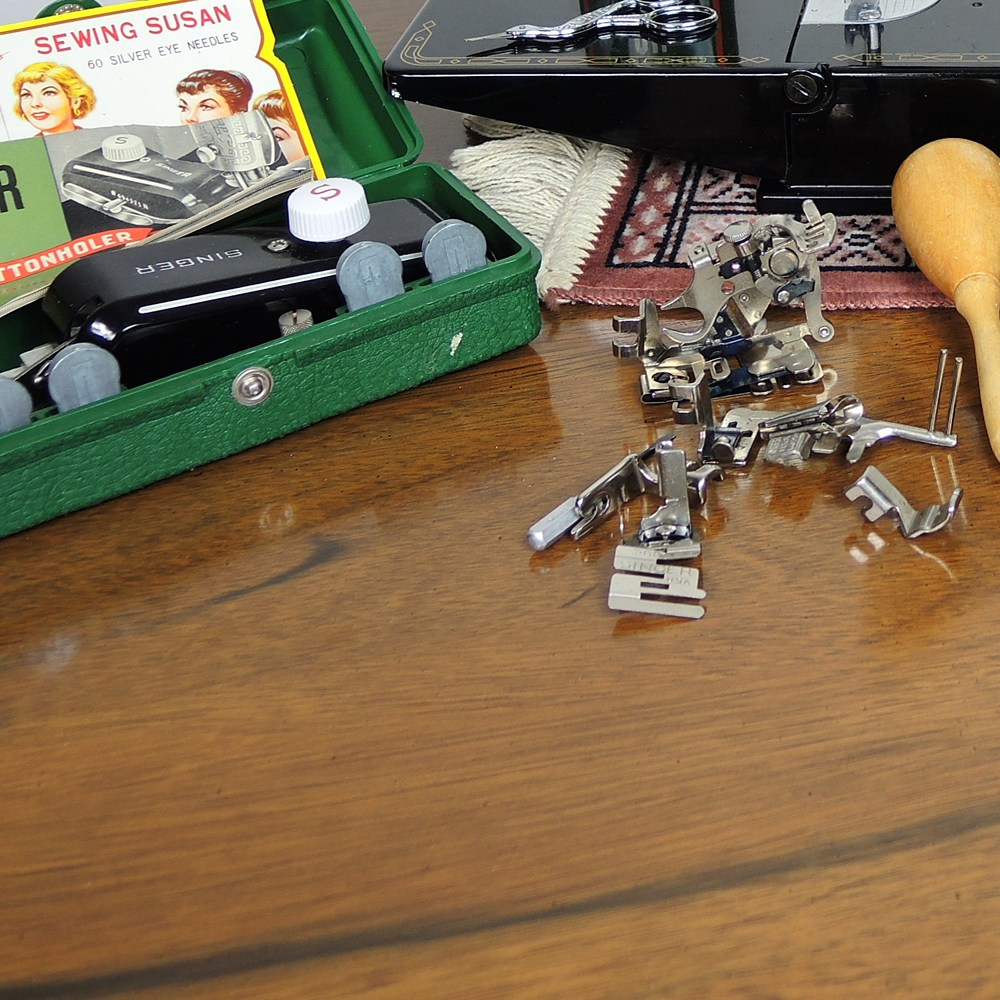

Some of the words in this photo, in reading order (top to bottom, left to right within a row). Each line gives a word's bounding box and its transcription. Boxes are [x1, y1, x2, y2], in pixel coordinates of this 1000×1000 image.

[34, 21, 138, 55] SEWING
[145, 4, 232, 35] SUSAN
[87, 58, 104, 70] 60
[109, 49, 152, 66] SILVER
[158, 43, 182, 57] EYE
[187, 31, 239, 51] NEEDLES
[310, 183, 341, 202] S
[0, 230, 133, 282] TTONHOLER
[135, 248, 243, 276] SINGER
[620, 561, 692, 577] SINGER
